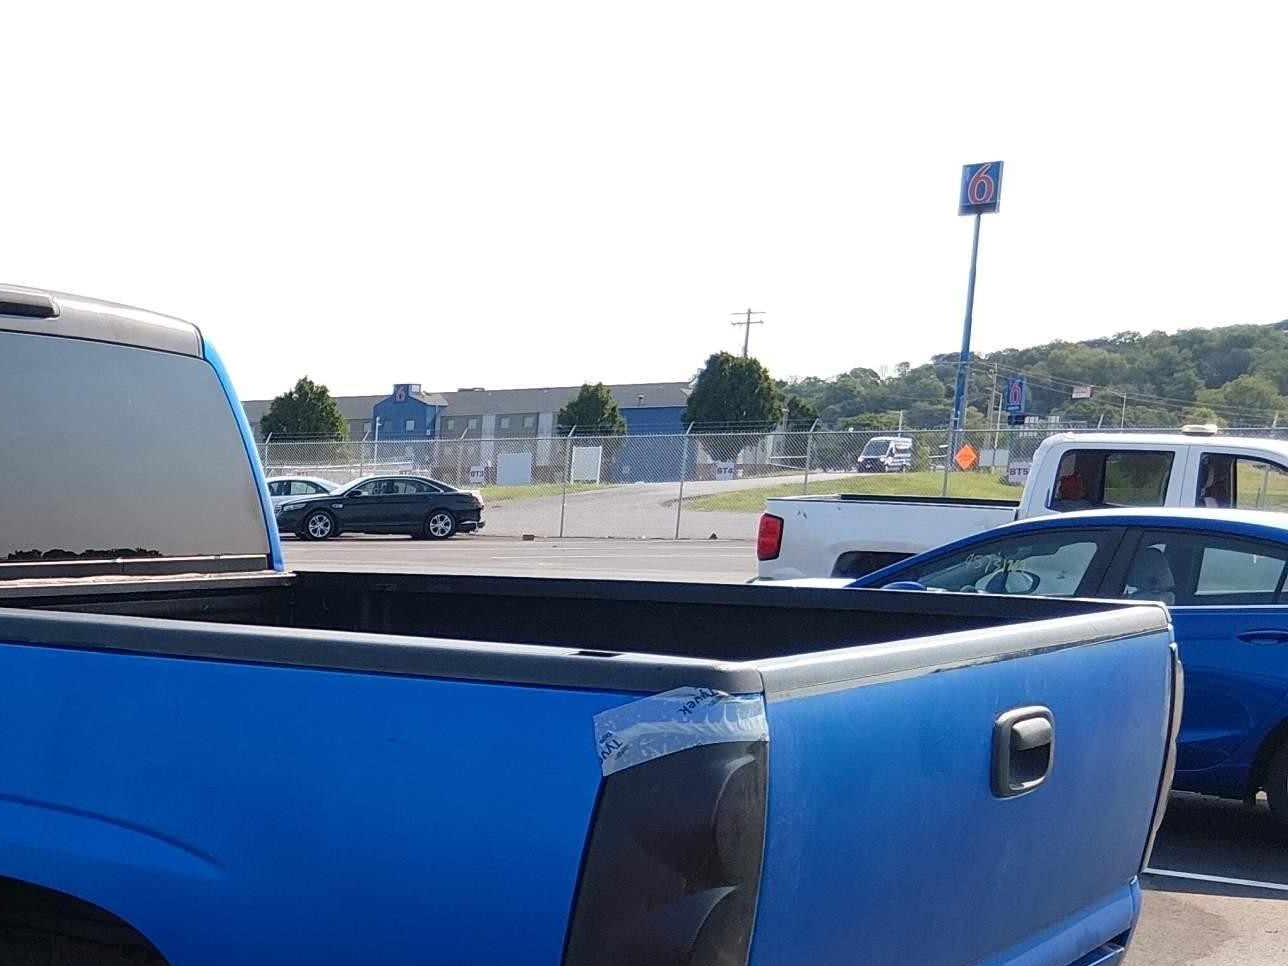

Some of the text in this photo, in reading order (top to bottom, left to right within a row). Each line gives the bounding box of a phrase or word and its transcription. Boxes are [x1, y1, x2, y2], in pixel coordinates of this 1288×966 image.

[968, 163, 995, 205] 6
[395, 385, 406, 402] 6
[679, 687, 718, 715] Tyvek
